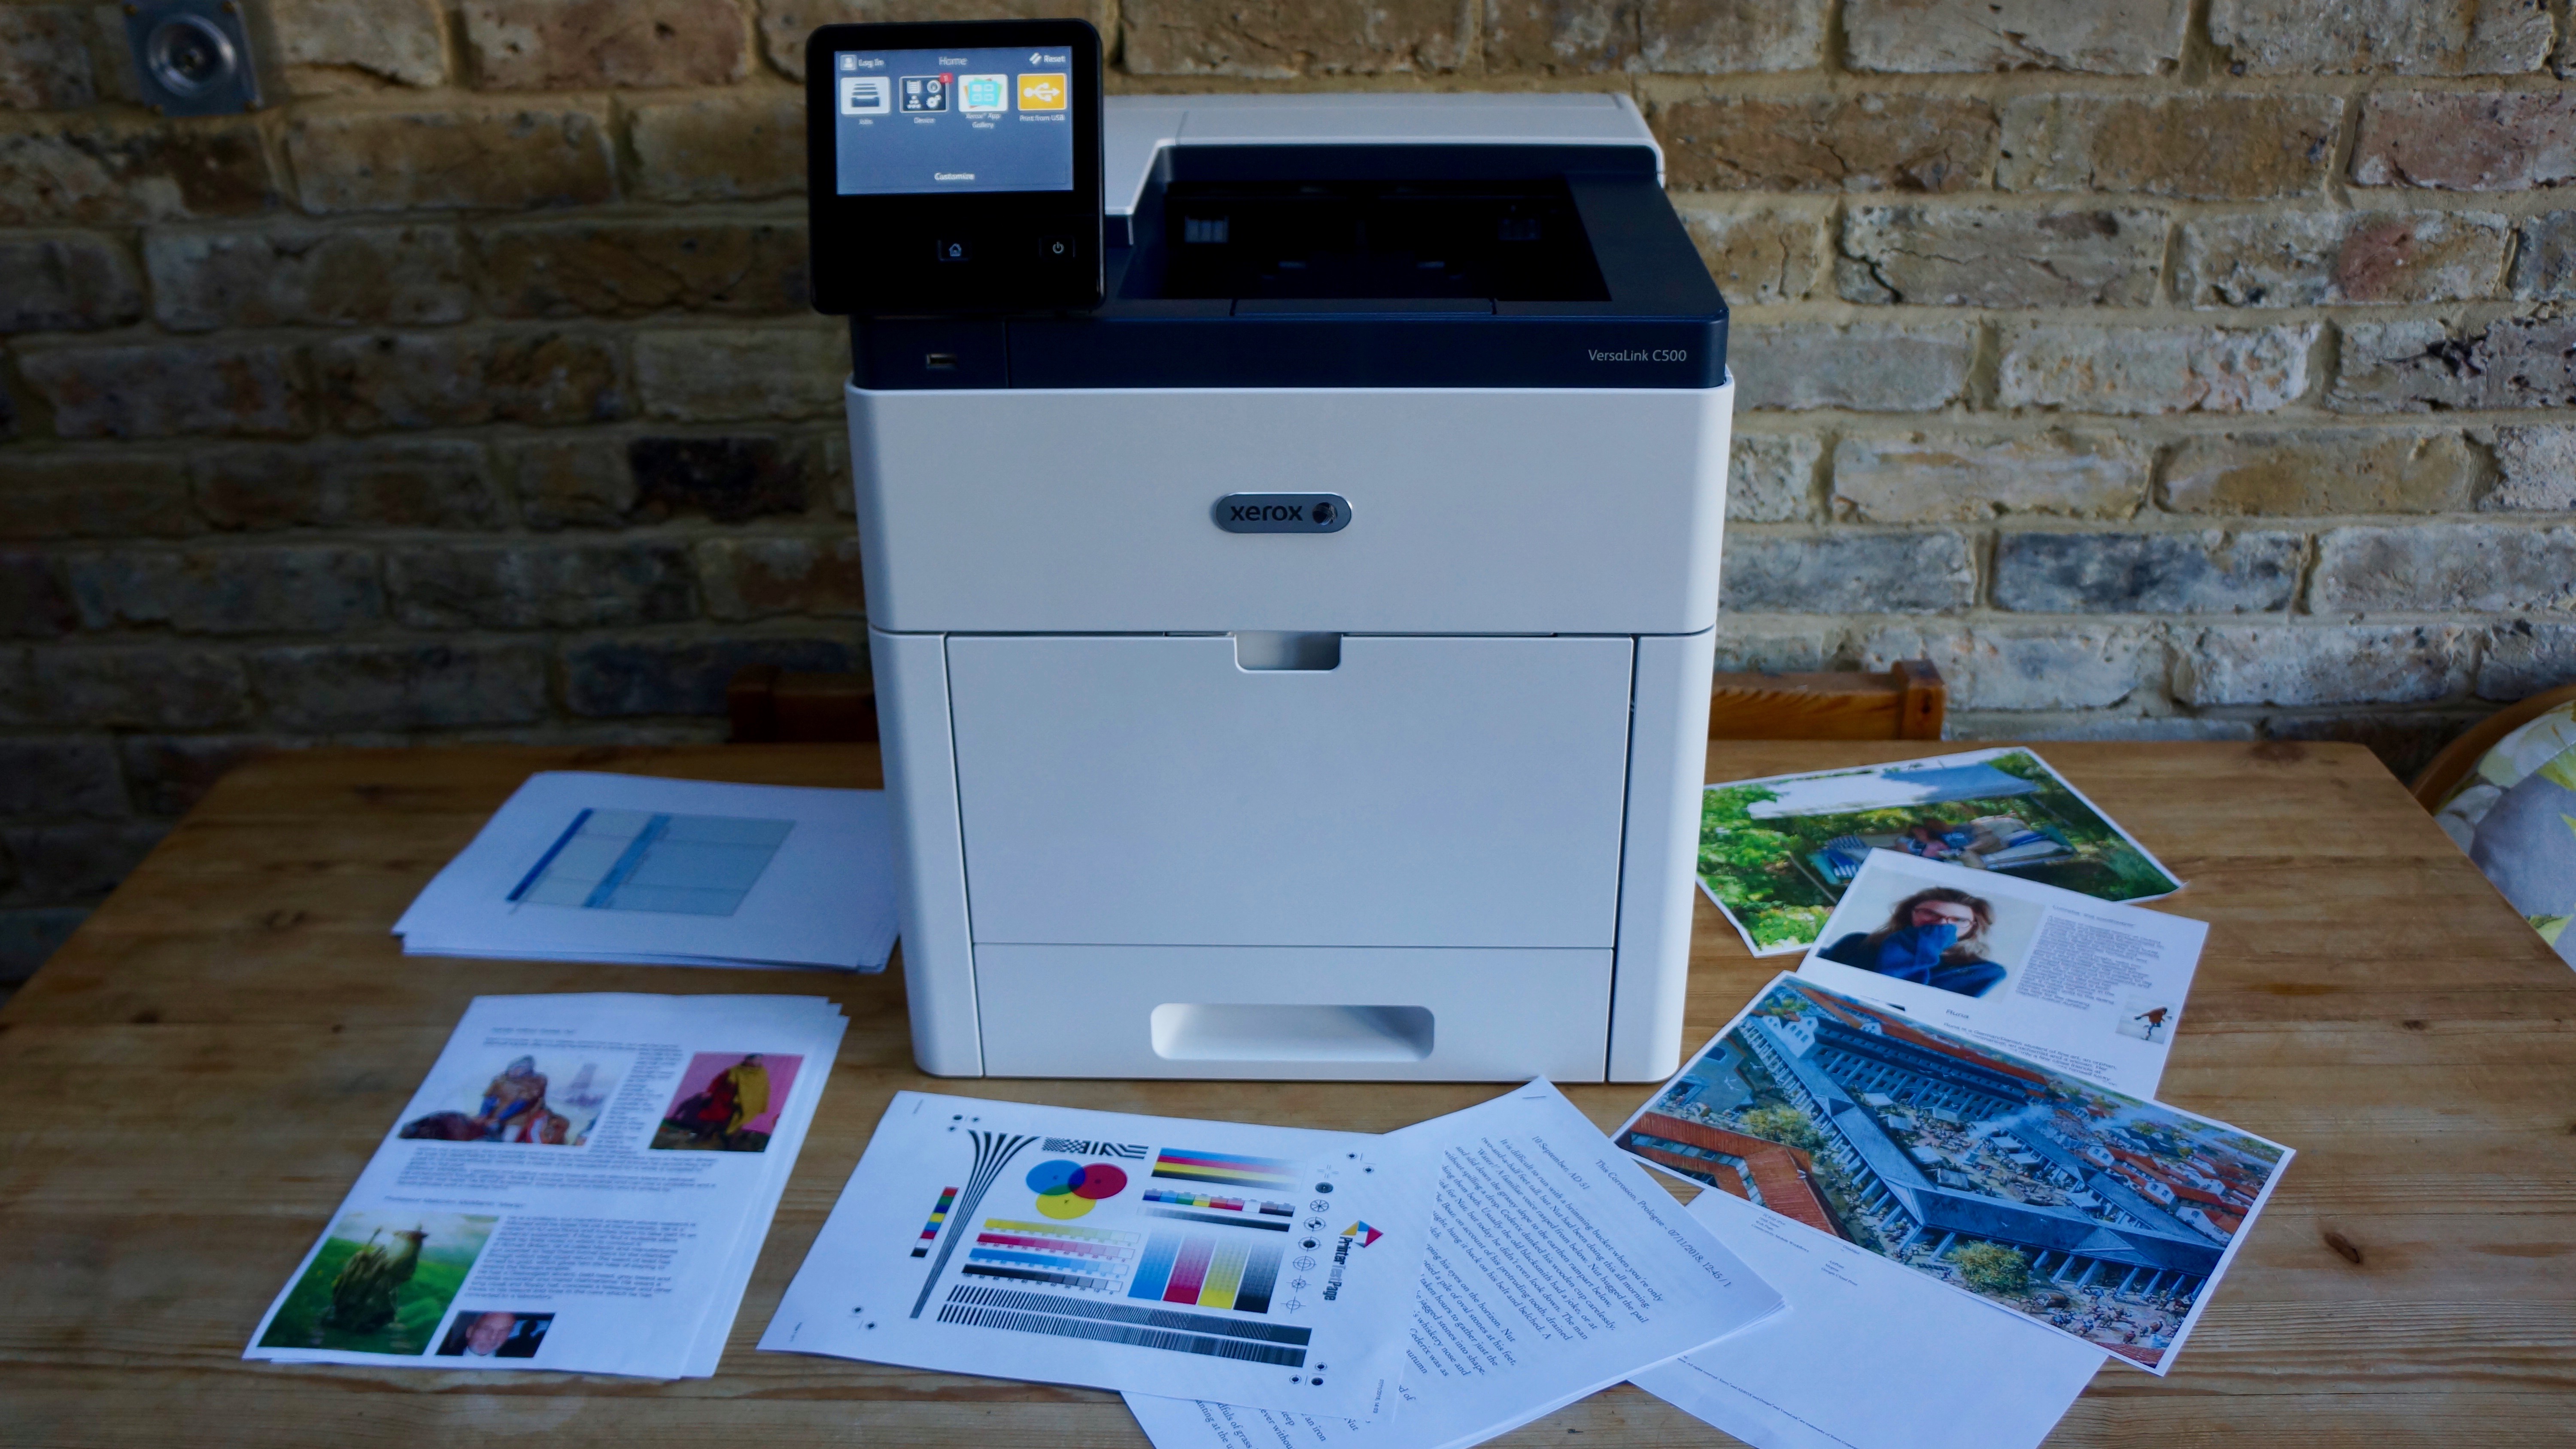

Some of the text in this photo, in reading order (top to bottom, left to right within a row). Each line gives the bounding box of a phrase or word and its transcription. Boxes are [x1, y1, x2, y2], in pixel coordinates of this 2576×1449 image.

[939, 56, 968, 66] Home
[934, 173, 975, 181] Customize
[1588, 349, 1686, 361] VersaLink C500
[1230, 505, 1303, 521] xerox
[1568, 1173, 1583, 1182] AD
[1441, 1164, 1455, 1179] hing
[1453, 1179, 1468, 1193] them
[1467, 1192, 1482, 1208] both.
[1481, 1206, 1503, 1229] Usually
[1501, 1229, 1512, 1239] the
[1510, 1239, 1525, 1250] old
[1520, 1248, 1553, 1282] blacksmith
[1549, 1280, 1566, 1294] had
[1564, 1298, 1581, 1314] joke,
[1444, 1150, 1464, 1171] without
[1461, 1170, 1483, 1191] spilling
[1500, 1209, 1523, 1232] Cederix
[1521, 1232, 1547, 1254] dunked
[1542, 1252, 1553, 1264] his
[1552, 1263, 1575, 1288] wooden
[1574, 1288, 1587, 1300] cup
[1455, 1146, 1470, 1156] and
[1465, 1156, 1480, 1166] slid
[1475, 1166, 1492, 1182] down
[1490, 1181, 1501, 1191] the
[1497, 1191, 1518, 1208] grassy
[1516, 1208, 1532, 1223] slope
[1537, 1230, 1549, 1239] the
[1547, 1240, 1570, 1263] earthen
[1568, 1263, 1594, 1287] rampart
[1592, 1286, 1612, 1307] below,
[1481, 1137, 1523, 1174] two-and-a-half
[1518, 1173, 1531, 1185] feet
[1539, 1194, 1551, 1206] but
[1549, 1205, 1563, 1218] Nut
[1561, 1216, 1577, 1228] had
[1572, 1227, 1588, 1243] been
[1586, 1243, 1605, 1261] doing
[1603, 1261, 1616, 1273] this
[1614, 1273, 1627, 1281] all
[1622, 1281, 1650, 1309] morning.
[1510, 1149, 1534, 1170] difficult
[1537, 1176, 1549, 1187] run
[1548, 1186, 1563, 1199] with
[1565, 1203, 1594, 1231] brimming
[1592, 1229, 1614, 1251] bucket
[1612, 1250, 1629, 1268] when
[1625, 1267, 1649, 1287] you're
[1647, 1288, 1663, 1301] only
[1595, 1159, 1609, 1173] This
[1637, 1200, 1664, 1226] Prologue
[1702, 1262, 1722, 1279] 12:45
[1438, 1179, 1449, 1189] ink
[1446, 1189, 1457, 1198] for
[1467, 1211, 1479, 1222] but
[1476, 1222, 1494, 1238] today
[1492, 1237, 1501, 1246] he
[1499, 1247, 1519, 1264] didn't
[1516, 1264, 1531, 1279] even
[1529, 1278, 1545, 1293] look
[1542, 1293, 1560, 1312] down.
[1561, 1312, 1574, 1325] The
[1573, 1326, 1588, 1340] man
[1501, 1174, 1523, 1195] familiar
[1522, 1195, 1537, 1210] voice
[1536, 1210, 1559, 1229] rasped
[1554, 1228, 1570, 1244] from
[1569, 1242, 1588, 1263] below.
[1587, 1263, 1602, 1276] Nut
[1600, 1275, 1627, 1300] hugged
[1622, 1300, 1634, 1310] the
[1630, 1311, 1649, 1323] pail
[1426, 1243, 1515, 1342] ping his eyes on the horizon. Nut
[1423, 1260, 1440, 1276] tied
[1437, 1280, 1452, 1292] pile
[1456, 1300, 1473, 1314] oval
[1468, 1314, 1488, 1334] stones
[1492, 1340, 1504, 1352] his
[1501, 1350, 1516, 1366] feet,
[1406, 1349, 1428, 1374] autumn
[1212, 1422, 1220, 1431] at
[1218, 1428, 1229, 1443] the
[1217, 1402, 1233, 1421] dfuls
[1231, 1420, 1243, 1430] of
[1261, 1409, 1295, 1449] ever withou
[1282, 1411, 1295, 1426] eep
[1304, 1418, 1326, 1442] an iron
